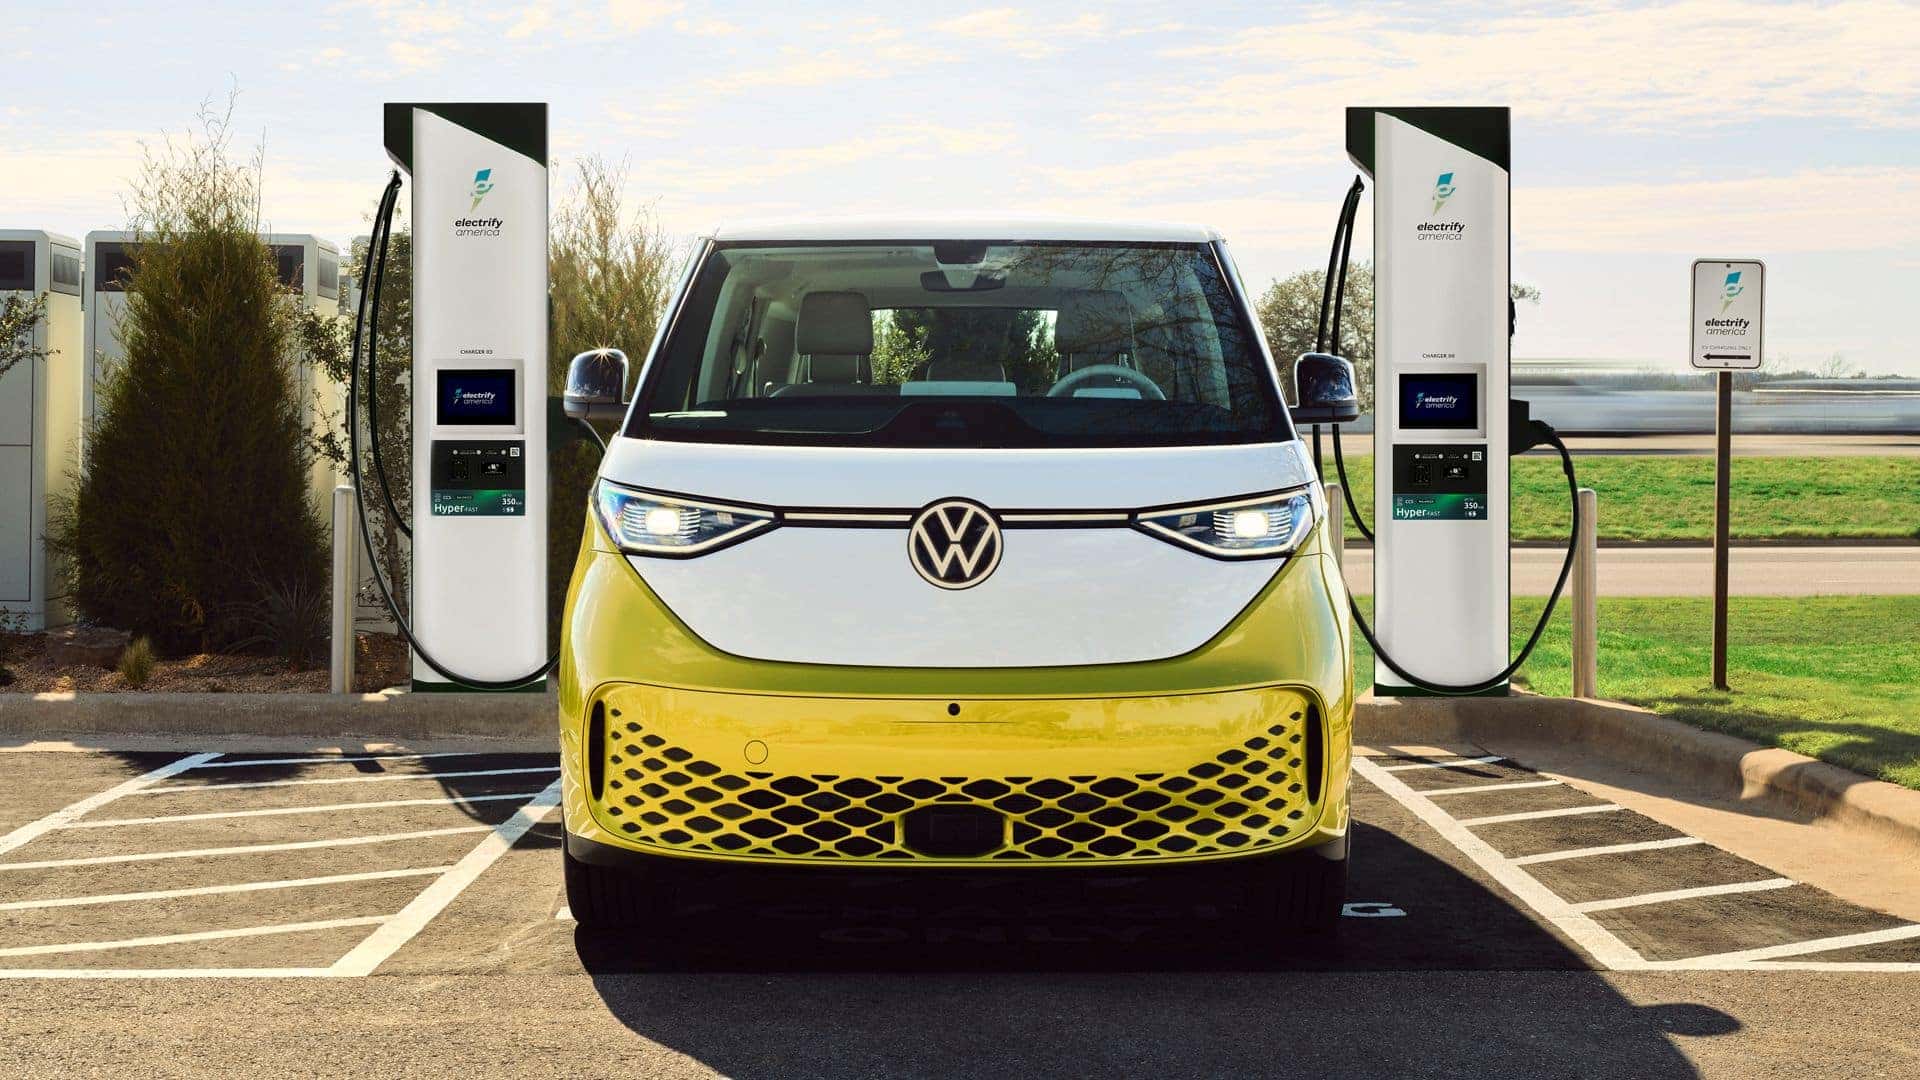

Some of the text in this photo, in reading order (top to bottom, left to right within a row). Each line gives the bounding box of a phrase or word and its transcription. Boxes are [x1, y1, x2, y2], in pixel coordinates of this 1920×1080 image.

[455, 217, 503, 229] electrify
[1417, 221, 1465, 233] electrify
[456, 229, 500, 237] america
[1418, 233, 1462, 241] america
[1705, 318, 1750, 329] electrify
[1706, 327, 1746, 336] america
[462, 391, 496, 400] electrify
[1424, 395, 1458, 404] electrify
[501, 498, 516, 506] 350
[1463, 502, 1478, 510] 350
[434, 503, 464, 515] Hyper
[1396, 507, 1427, 519] Hyper
